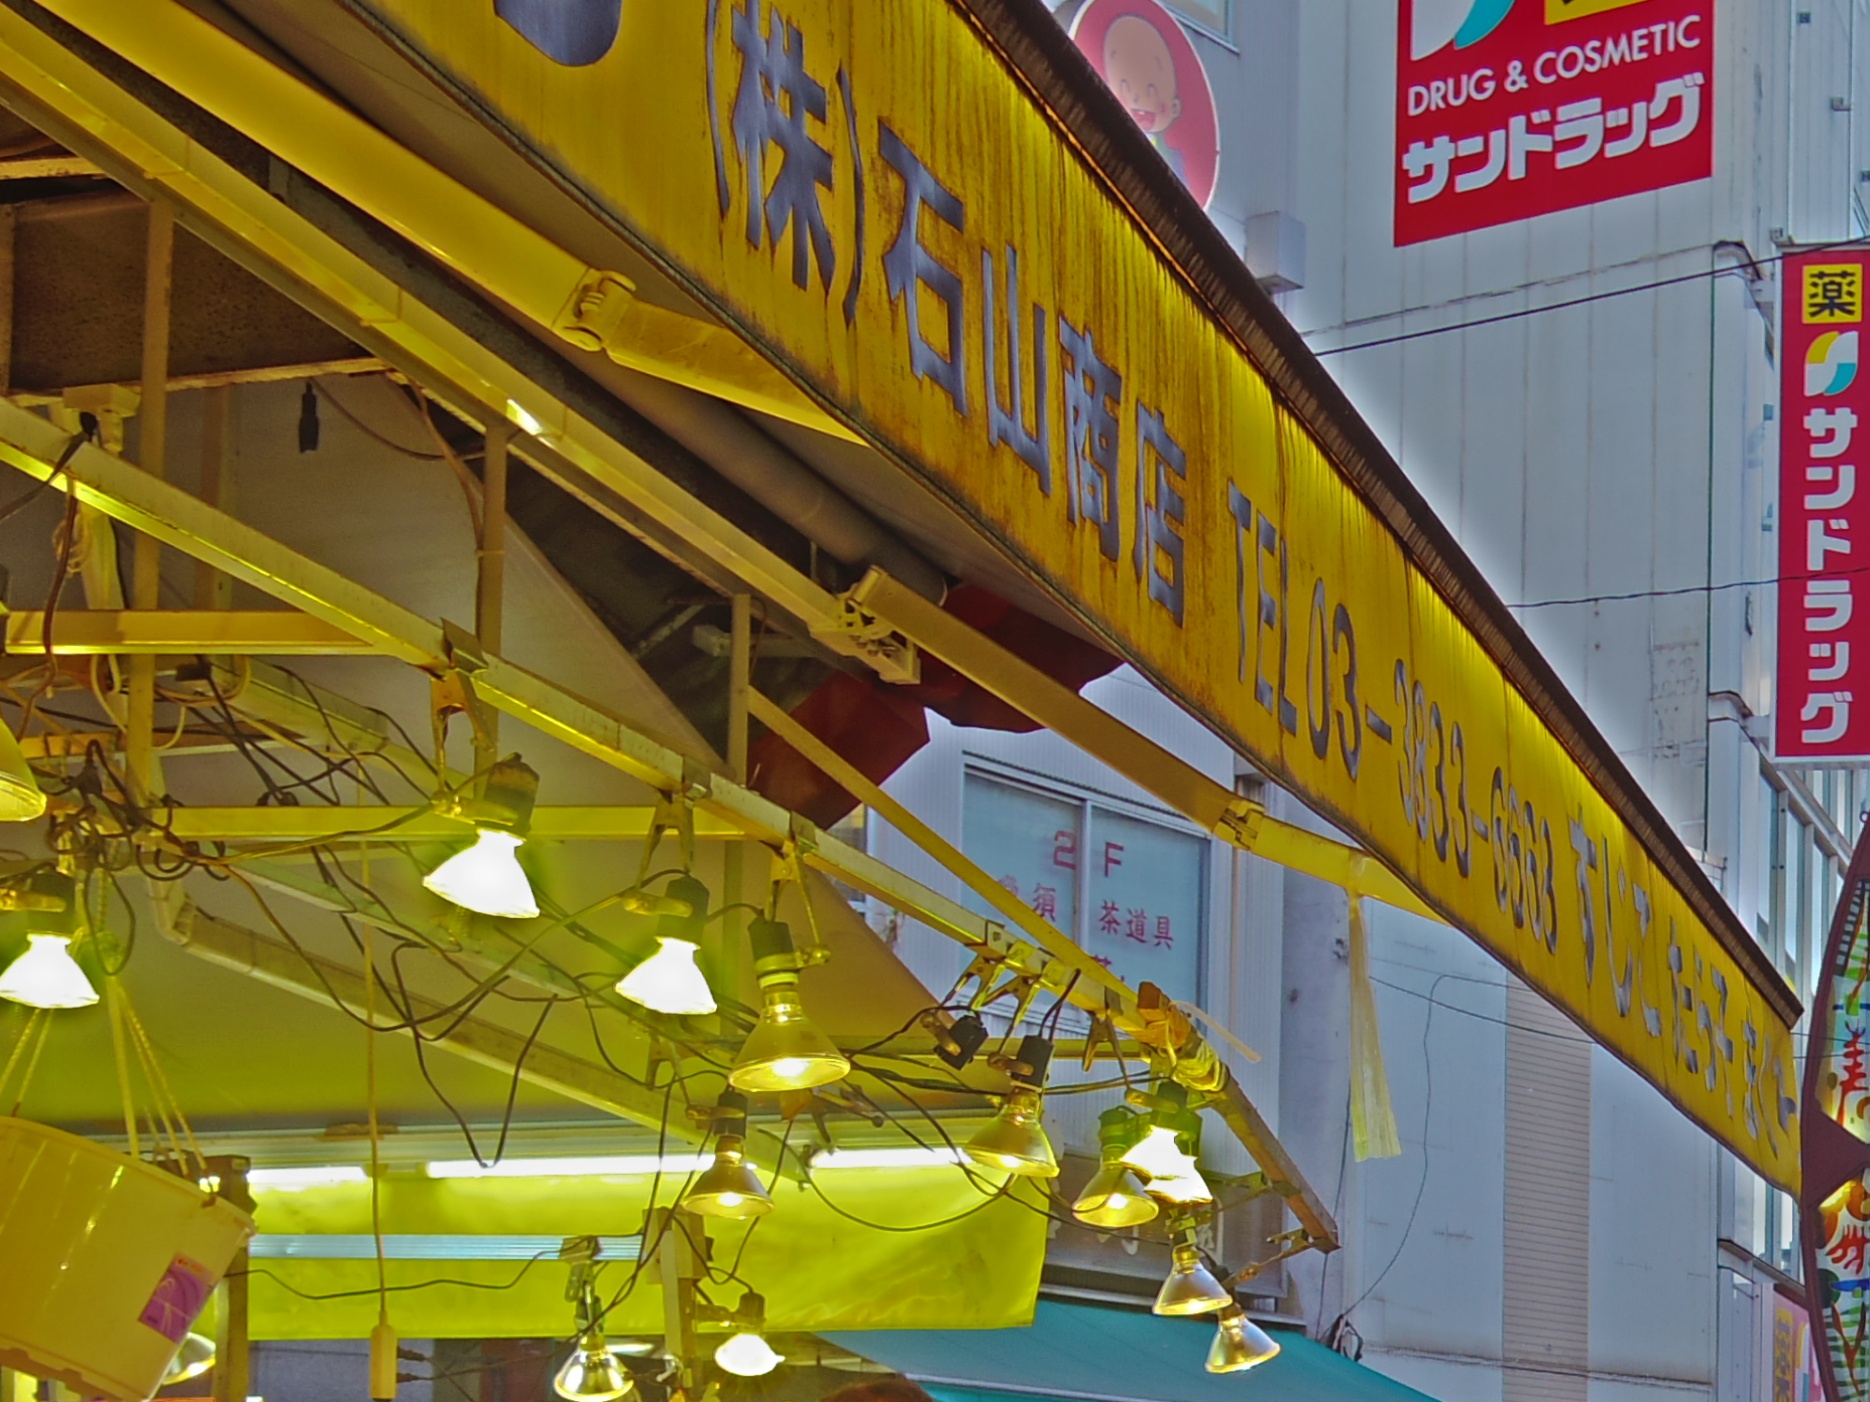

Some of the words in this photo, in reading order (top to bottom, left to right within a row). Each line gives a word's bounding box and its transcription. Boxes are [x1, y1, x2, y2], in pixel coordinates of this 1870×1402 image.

[1408, 68, 1497, 117] DRUG
[1504, 60, 1529, 93] &
[1533, 14, 1701, 84] COSMETIC
[1402, 71, 1705, 204] サンドラッグ
[1810, 271, 1856, 318] 薬
[1227, 479, 1297, 736] TEL
[1801, 407, 1858, 744] サンドラッグ
[1099, 900, 1175, 950] 茶道具
